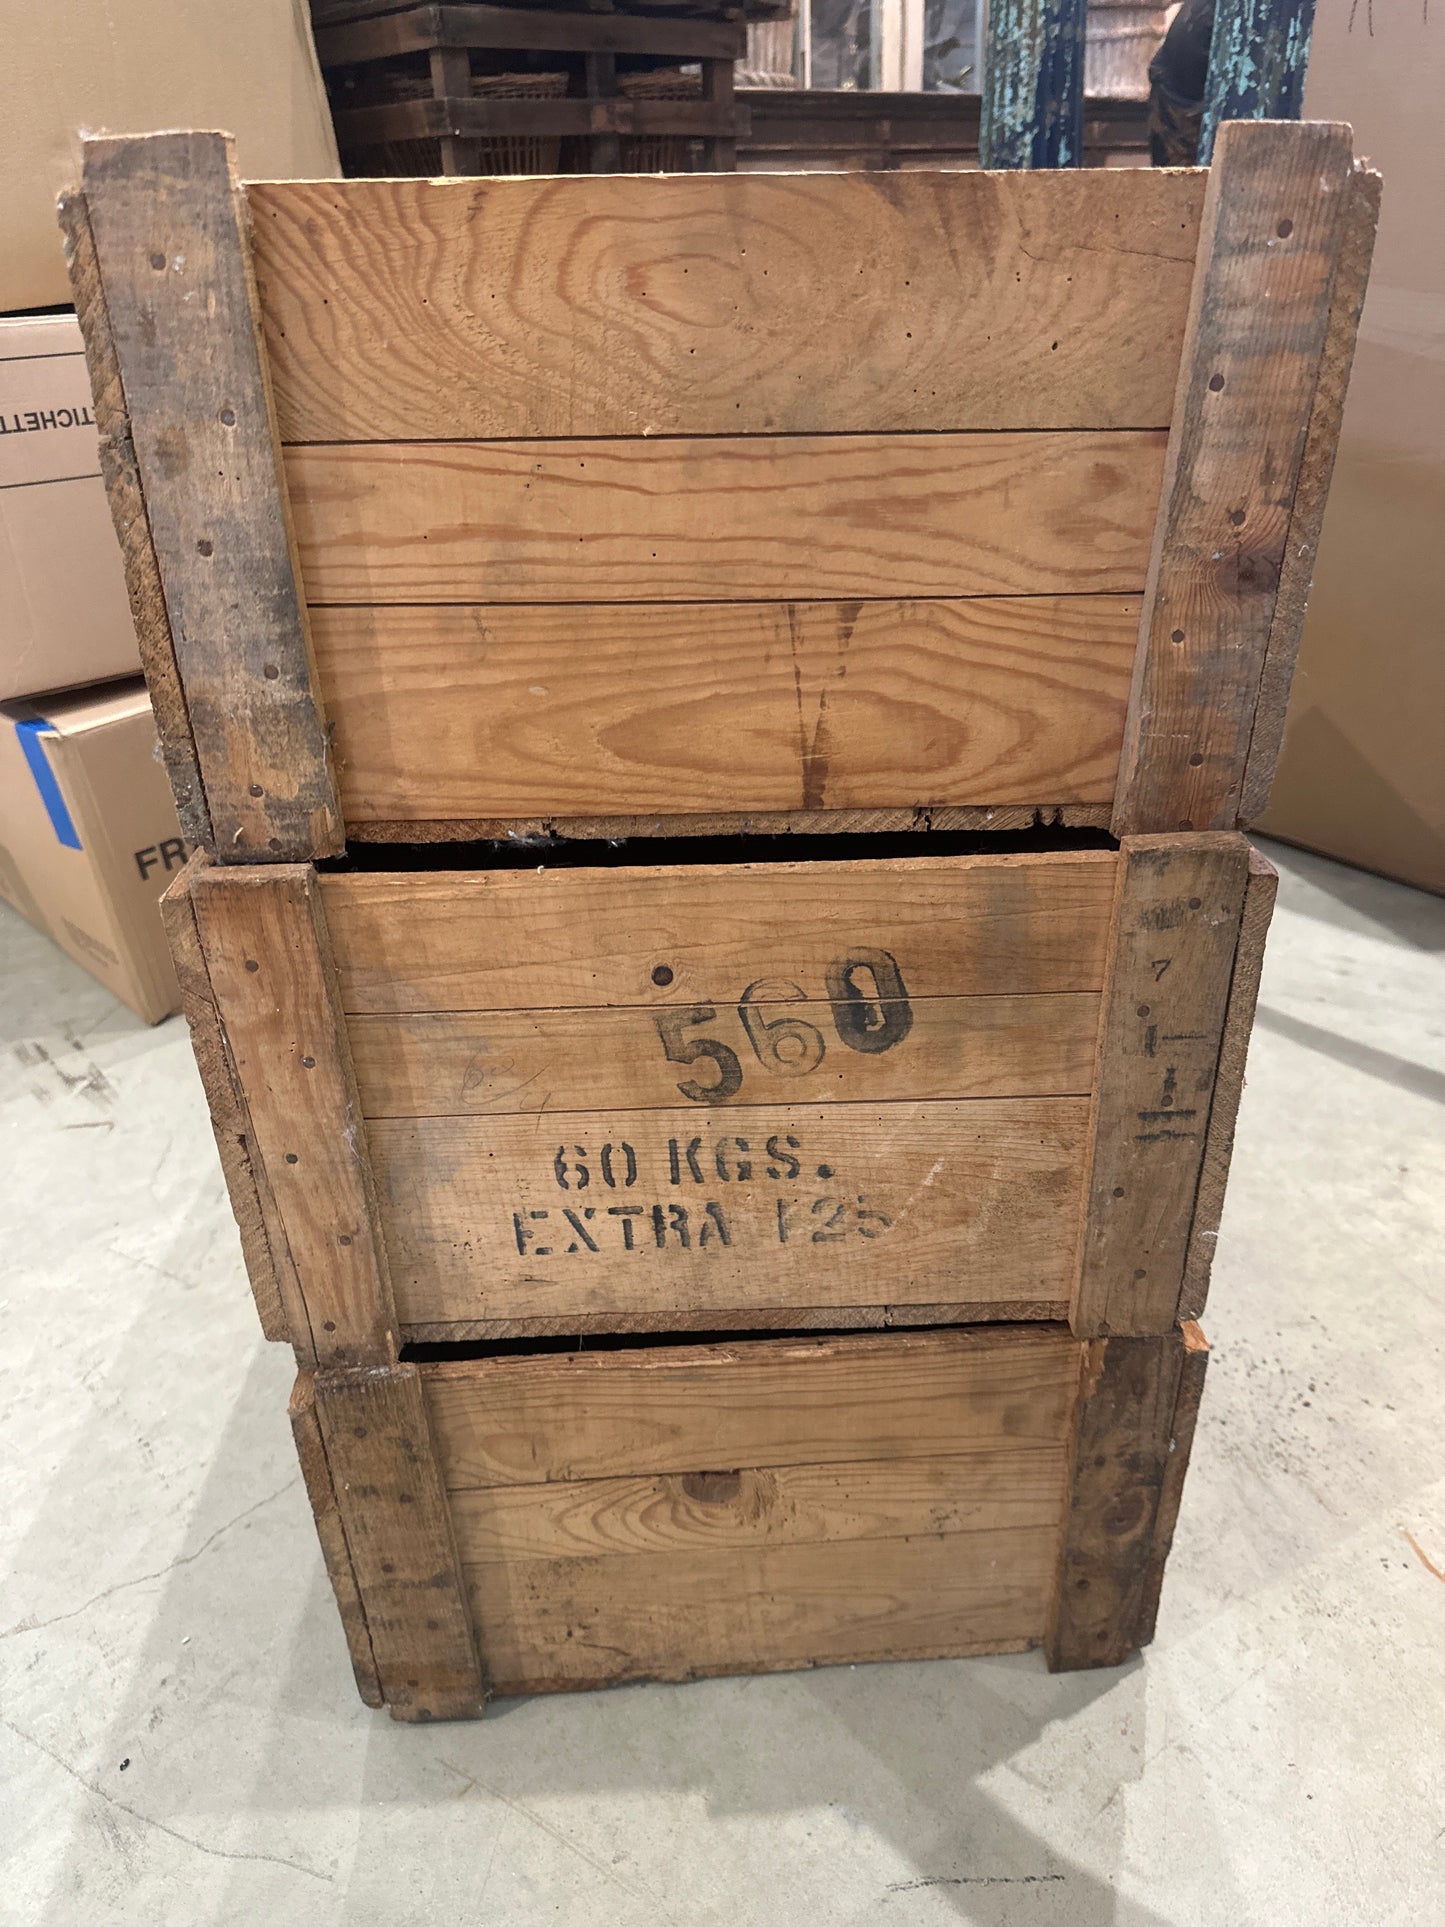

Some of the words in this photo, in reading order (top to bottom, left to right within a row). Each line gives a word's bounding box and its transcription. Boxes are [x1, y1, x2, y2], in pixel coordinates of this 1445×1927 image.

[0, 406, 97, 435] TICHETT
[652, 945, 914, 1102] 560
[553, 1141, 638, 1190] 60
[668, 1135, 835, 1186] KGS.
[512, 1200, 732, 1256] EXTRA
